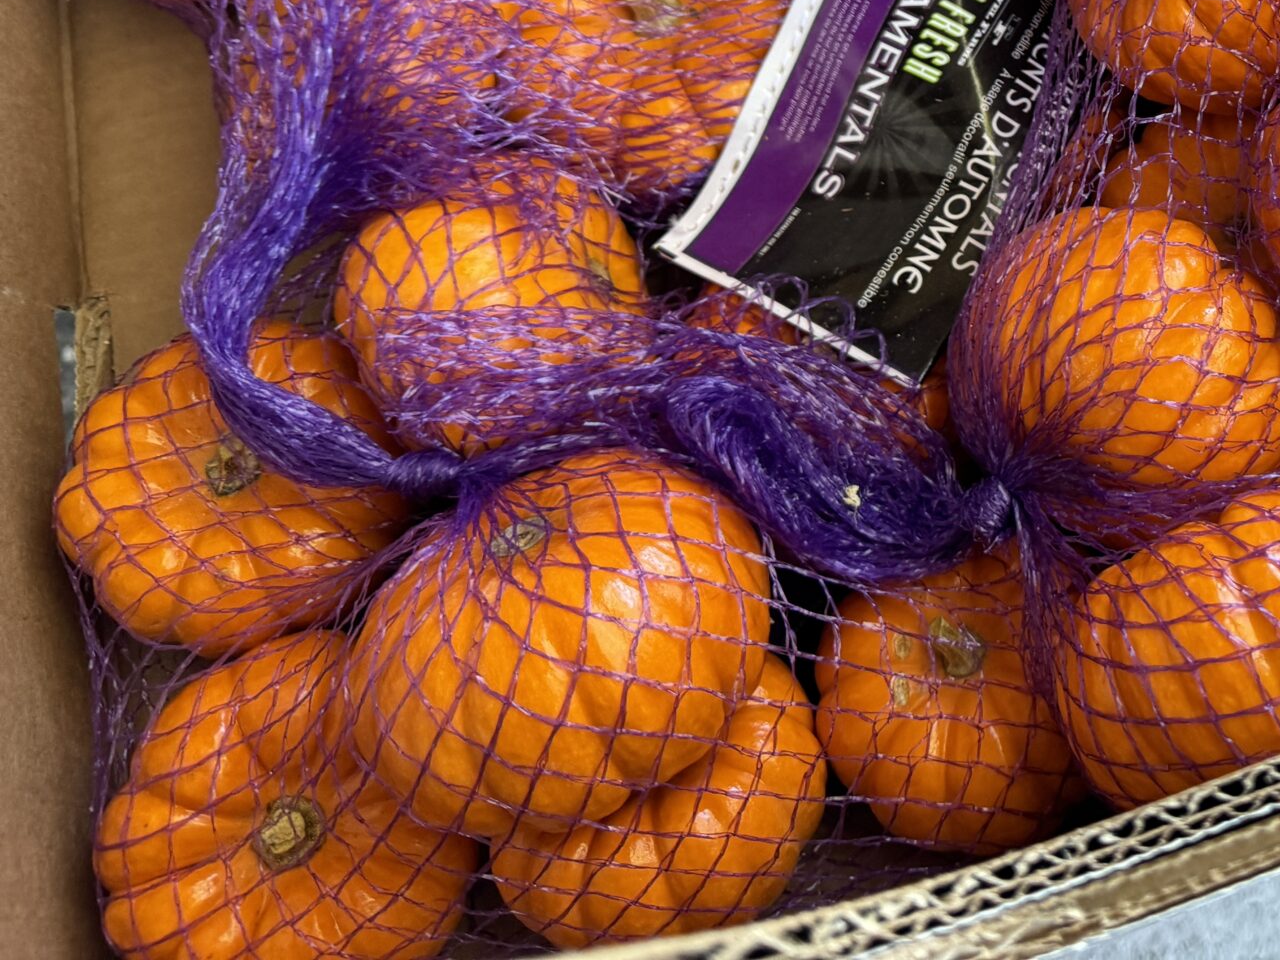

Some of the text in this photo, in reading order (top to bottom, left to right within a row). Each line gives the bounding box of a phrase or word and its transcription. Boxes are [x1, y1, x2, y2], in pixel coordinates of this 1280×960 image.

[976, 76, 1006, 114] usage
[951, 111, 988, 165] décoratif
[889, 108, 1022, 297] D'AUTOMNE
[898, 163, 960, 247] seulement/non
[855, 244, 904, 311] comestible
